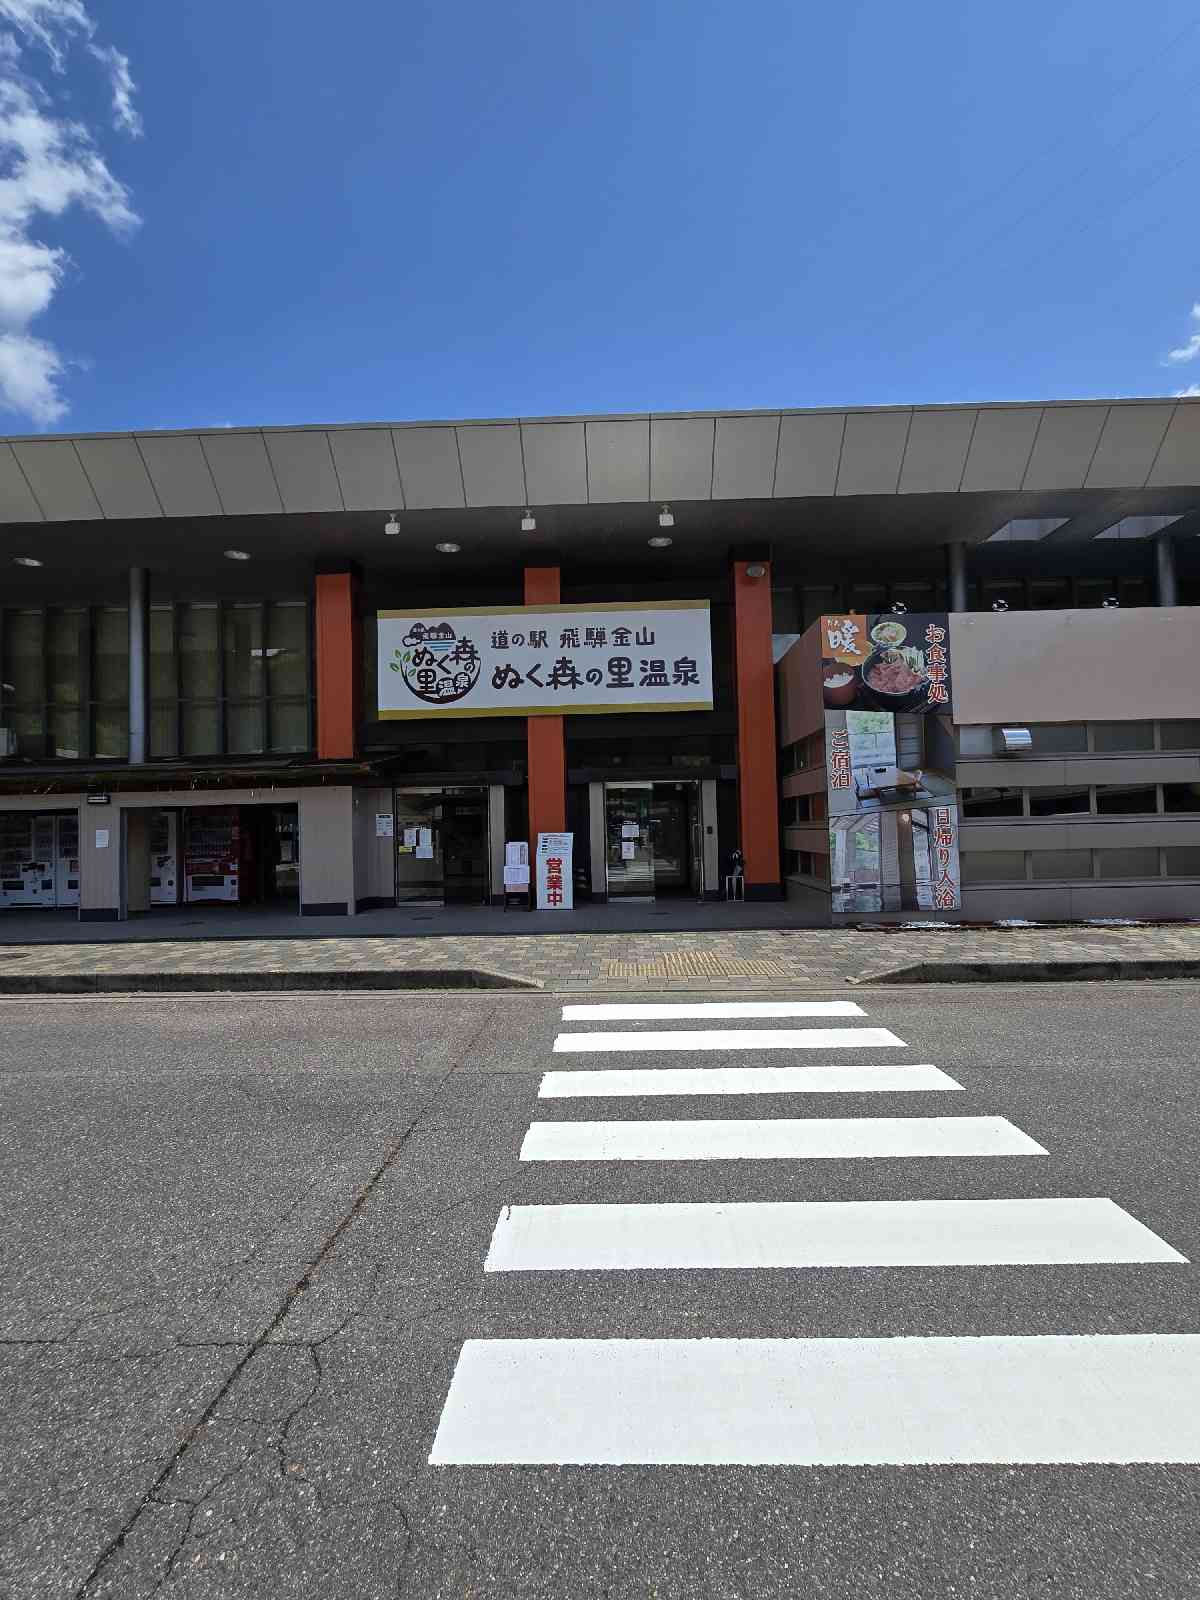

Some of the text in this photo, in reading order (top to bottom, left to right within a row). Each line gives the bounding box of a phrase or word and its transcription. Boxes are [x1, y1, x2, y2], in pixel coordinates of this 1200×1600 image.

[491, 626, 656, 649] 道の駅 飛騨金山
[925, 624, 949, 704] お食事処
[491, 656, 700, 690] ぬく森の里温泉
[831, 729, 850, 789] ご宿泊
[546, 857, 563, 906] 営業中
[934, 808, 955, 908] 日帰り入浴
